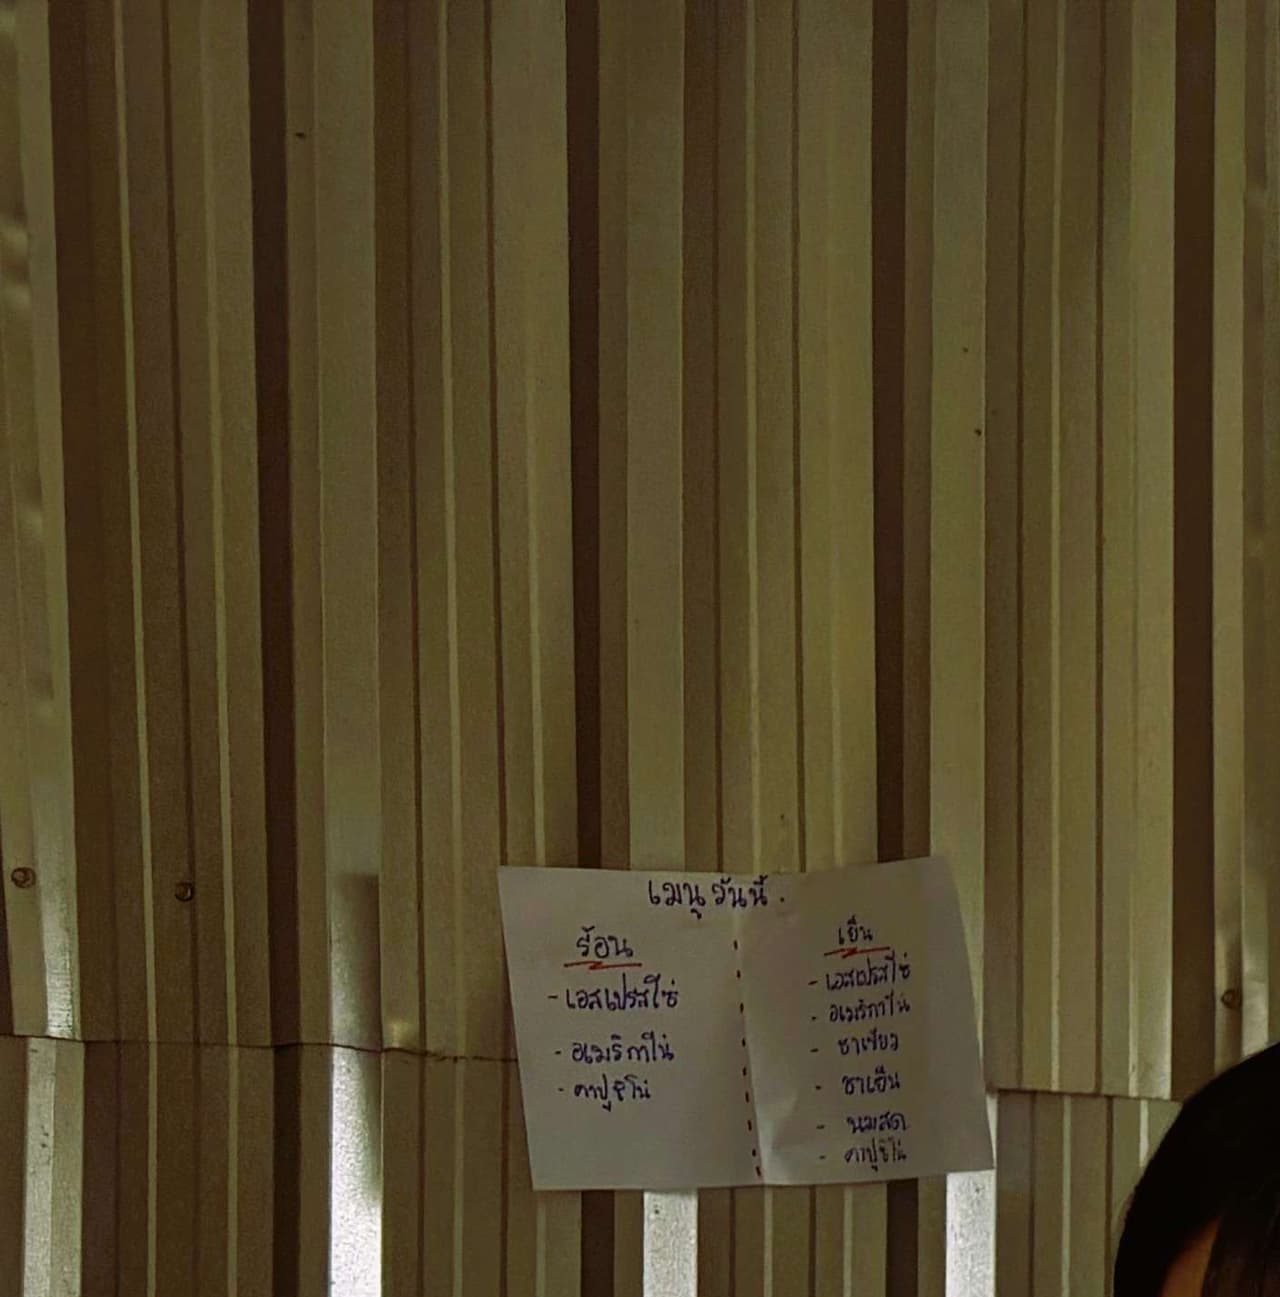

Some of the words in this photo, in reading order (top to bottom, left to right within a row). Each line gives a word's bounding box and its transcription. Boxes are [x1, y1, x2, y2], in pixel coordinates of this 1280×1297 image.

[576, 925, 633, 958] ร้อน
[838, 915, 873, 944] เย็น
[846, 1112, 907, 1133] นมสด
